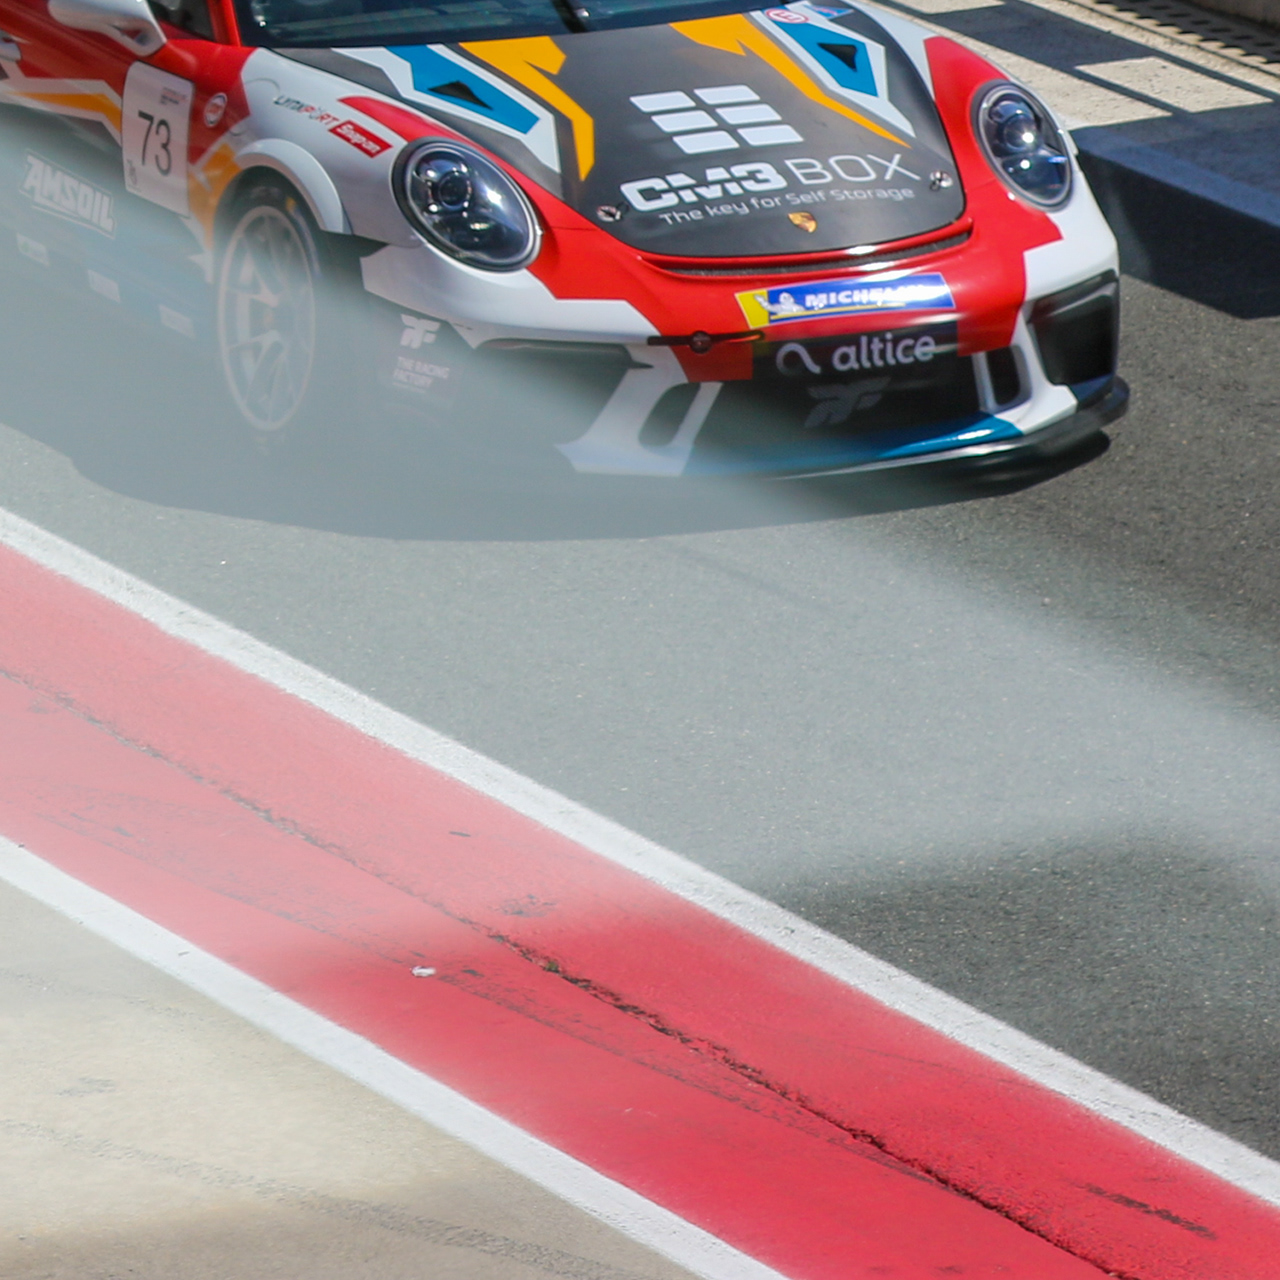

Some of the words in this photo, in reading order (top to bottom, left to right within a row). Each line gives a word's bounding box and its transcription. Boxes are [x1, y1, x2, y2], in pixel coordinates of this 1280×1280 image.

[138, 109, 172, 176] 73
[22, 153, 115, 233] AMSOIL
[619, 161, 788, 212] CM3
[784, 153, 922, 185] BOX
[658, 210, 704, 226] The
[705, 200, 751, 218] key
[750, 195, 782, 211] for
[786, 189, 827, 205] Self
[830, 187, 916, 203] Storage
[832, 331, 937, 372] altice
